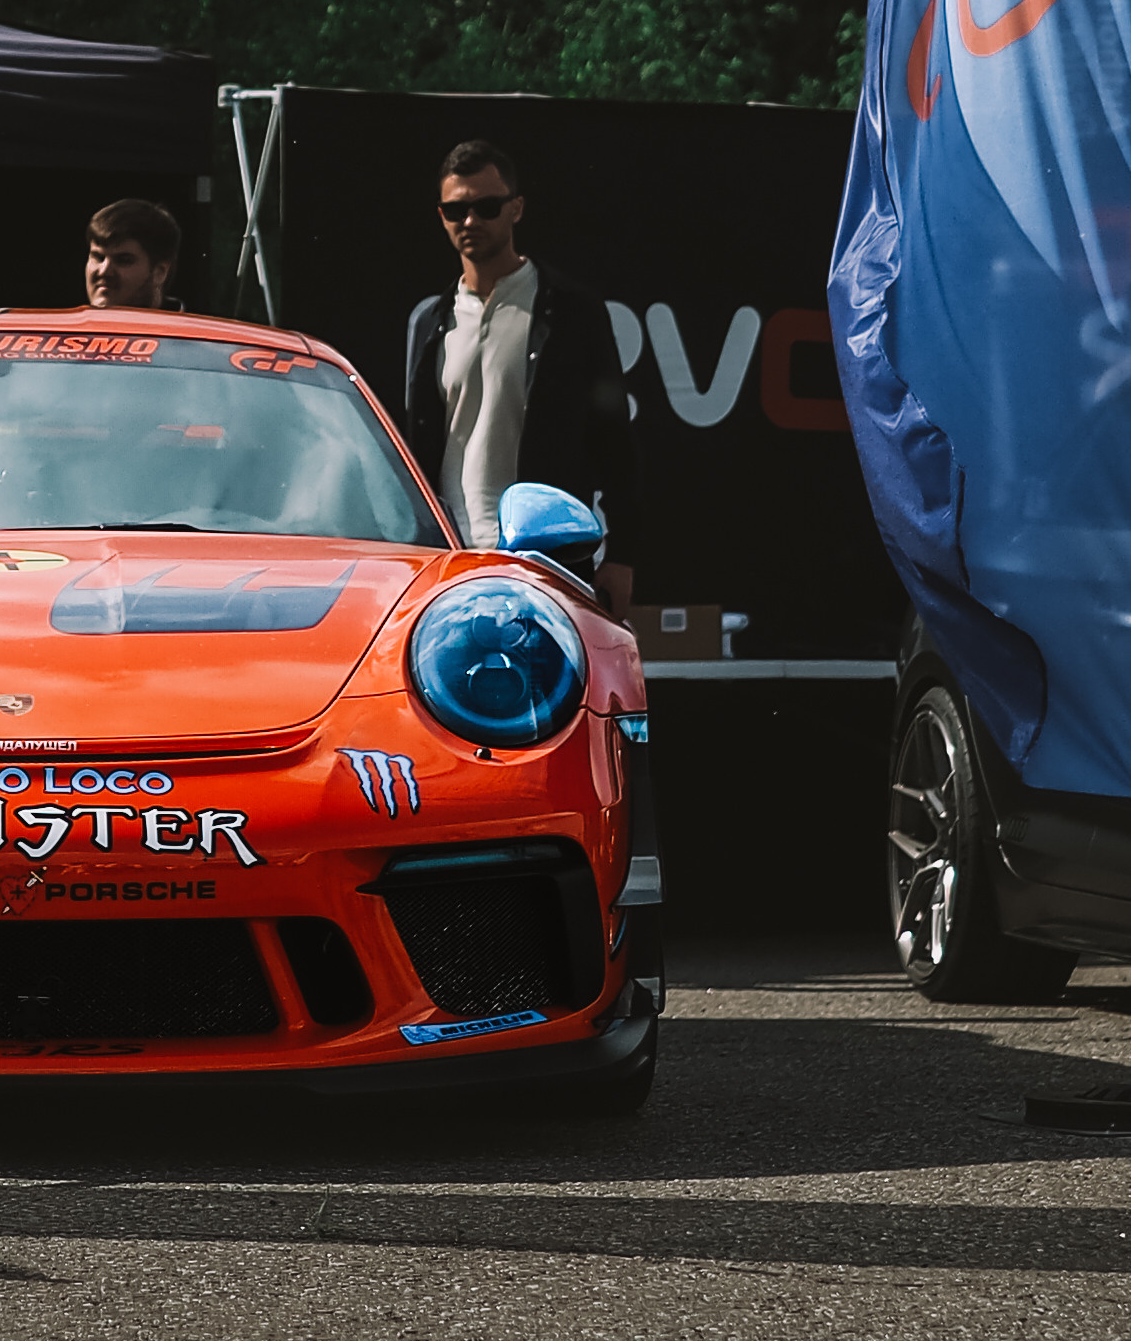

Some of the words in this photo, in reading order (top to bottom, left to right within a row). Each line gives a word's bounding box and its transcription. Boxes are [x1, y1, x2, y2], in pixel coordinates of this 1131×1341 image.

[25, 352, 153, 363] SIMULATOR
[44, 767, 175, 795] LOCO
[45, 881, 216, 901] PORSCHE
[439, 1012, 534, 1035] MICHELIN
